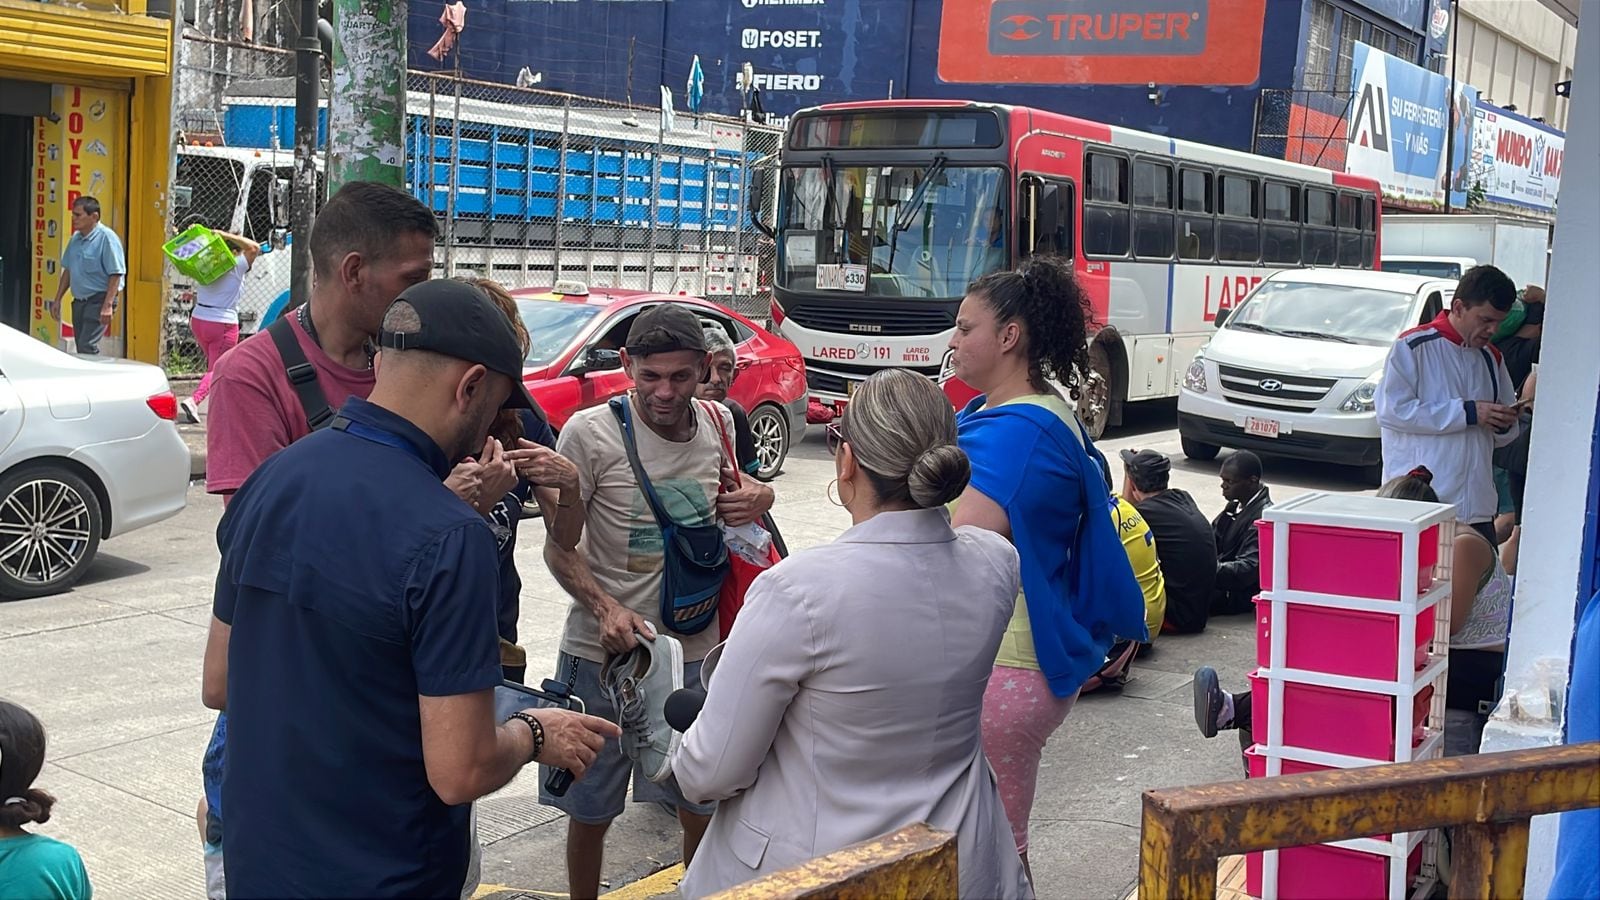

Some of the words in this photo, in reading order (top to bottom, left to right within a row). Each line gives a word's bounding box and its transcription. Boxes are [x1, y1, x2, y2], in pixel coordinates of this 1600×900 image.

[1047, 13, 1190, 41] TRUPER
[1391, 96, 1403, 117] SU
[1405, 131, 1412, 151] Y
[1411, 131, 1429, 156] MÁS
[1496, 127, 1532, 168] MUNDO
[35, 116, 46, 320] LECTRODOMESTICOS
[1203, 275, 1262, 321] LAR
[812, 346, 856, 360] LARED
[874, 346, 890, 359] 191
